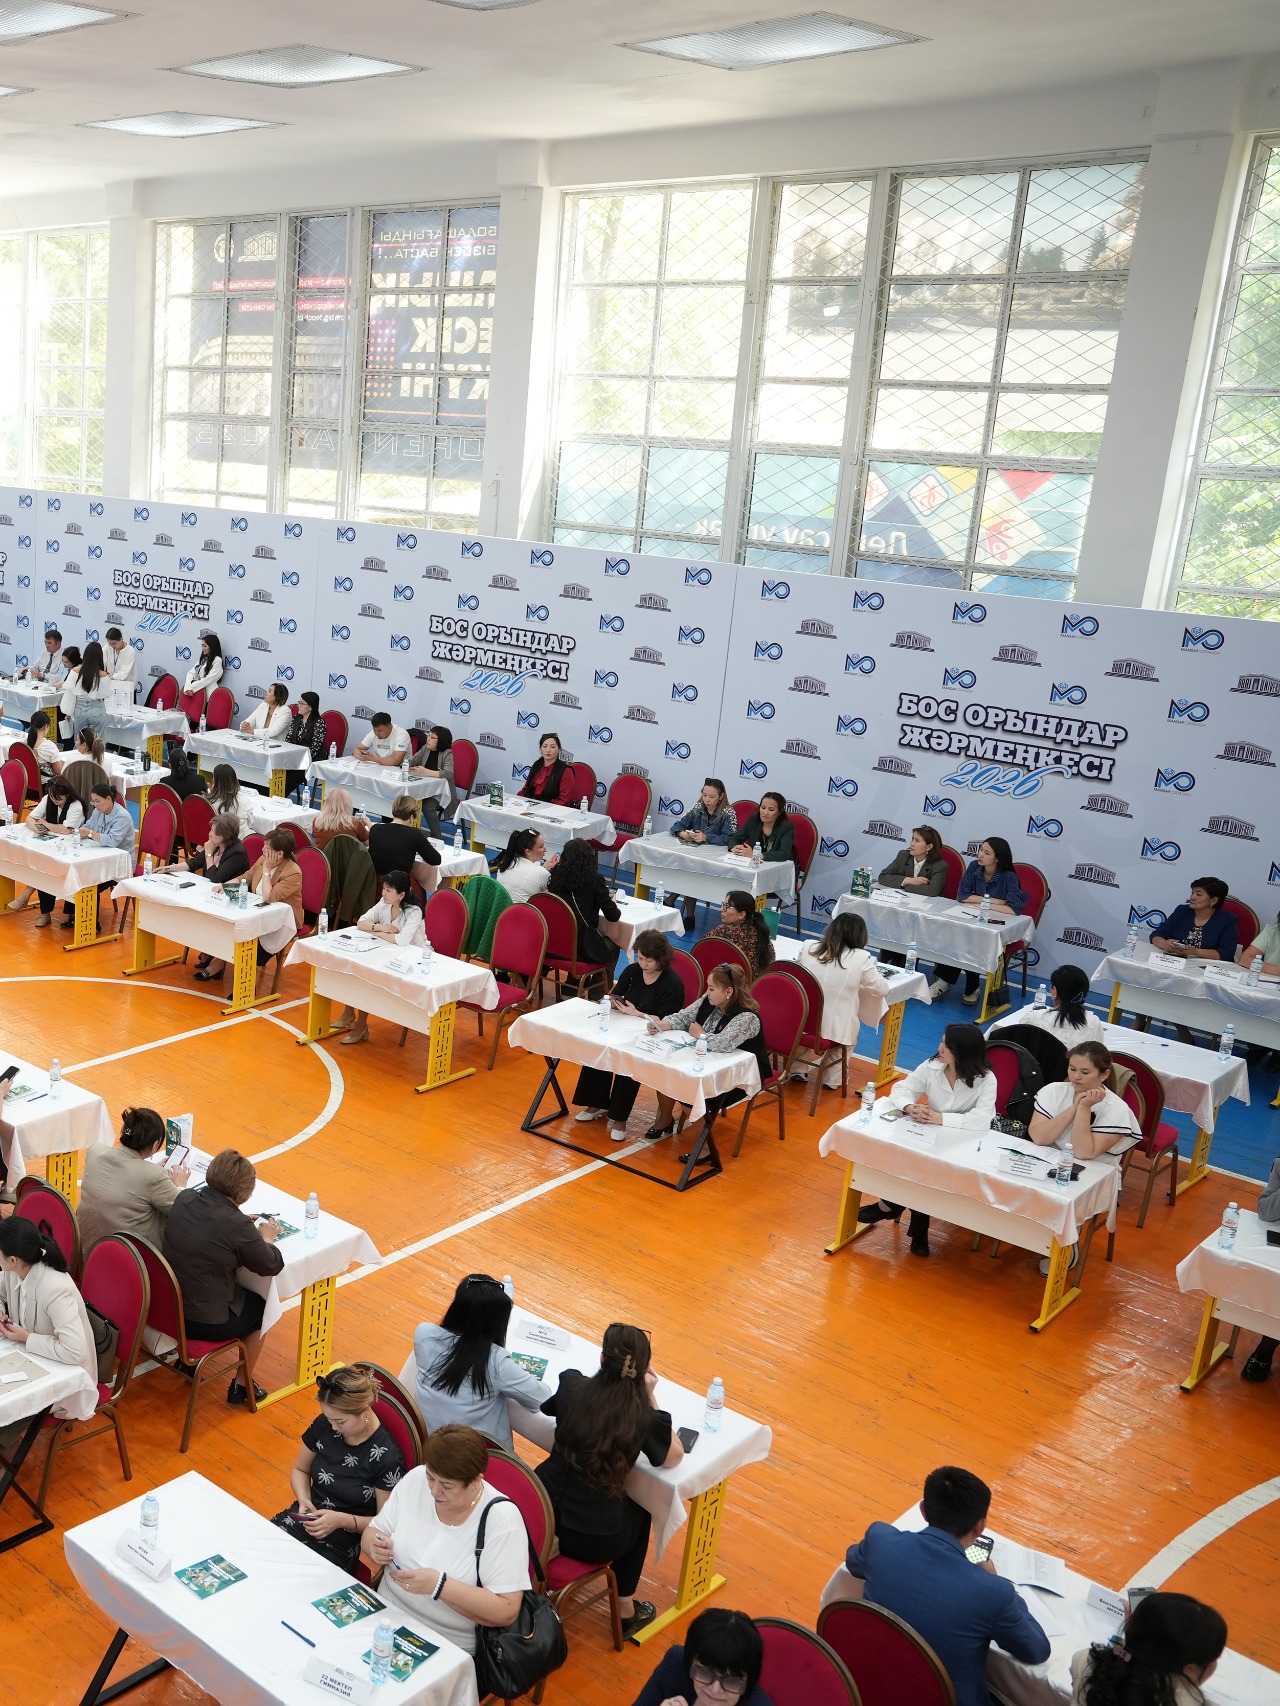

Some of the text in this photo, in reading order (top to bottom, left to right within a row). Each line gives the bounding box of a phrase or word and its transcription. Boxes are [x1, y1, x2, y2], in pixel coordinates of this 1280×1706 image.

[113, 569, 214, 599] БОС ОРЫНДАР
[115, 590, 210, 621] ЖӘРМЕҢКЕСІ
[136, 610, 193, 636] 2026
[429, 615, 575, 655] БОС ОРЫНДАР
[432, 640, 569, 682] ЖӘРМЕҢКЕСІ
[459, 668, 542, 698] 2026
[898, 693, 1127, 748] БОС ОРЫНДАР
[900, 723, 1115, 783] ЖӘРМЕҢКЕСІ
[940, 761, 1072, 800] 2026
[319, 1680, 351, 1697] ГИМНАЗИЯ
[321, 1673, 353, 1692] 22 МЕКТЕП
